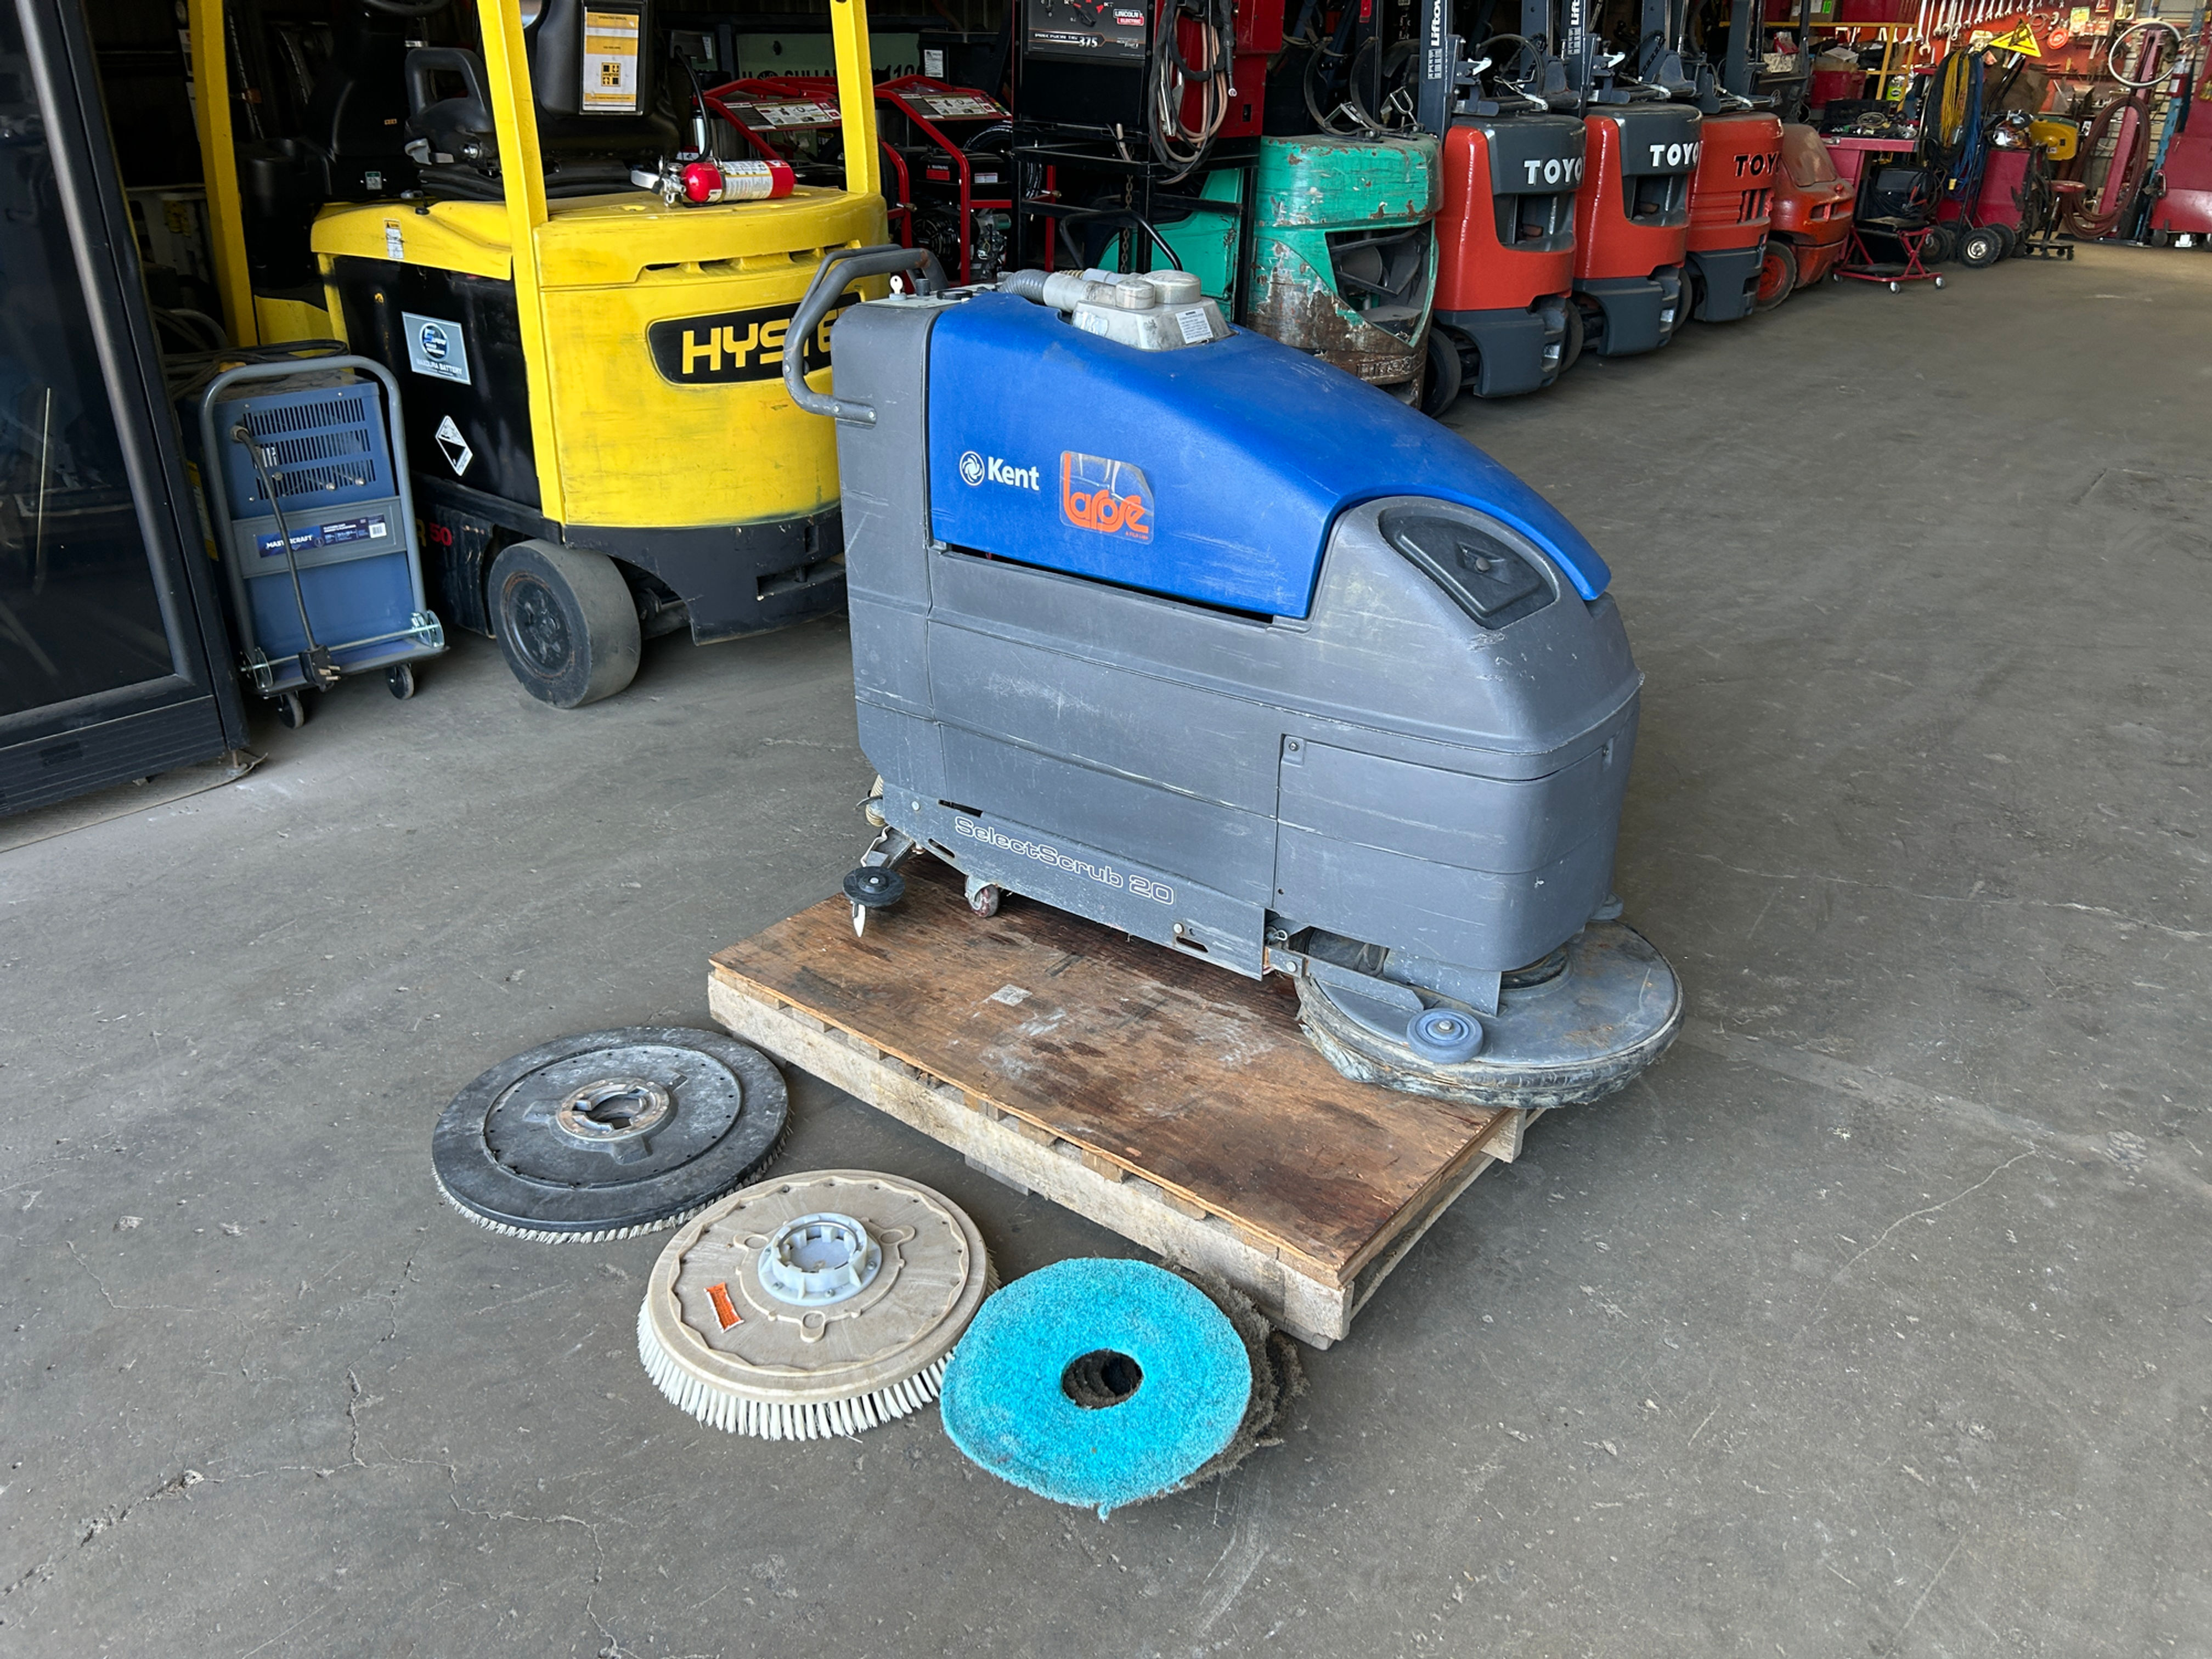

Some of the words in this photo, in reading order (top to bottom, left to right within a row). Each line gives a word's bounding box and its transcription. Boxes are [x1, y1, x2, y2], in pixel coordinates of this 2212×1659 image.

[1571, 0, 1580, 25] Lift
[1079, 36, 1098, 48] 375
[1650, 142, 1700, 167] TOYO
[1733, 151, 1779, 177] TOY
[1523, 156, 1583, 185] TOYO
[682, 307, 849, 375] HYSE
[988, 456, 1040, 491] Kent
[430, 523, 452, 546] 50
[955, 816, 1124, 888] SelectScrub
[1128, 874, 1174, 906] 20
